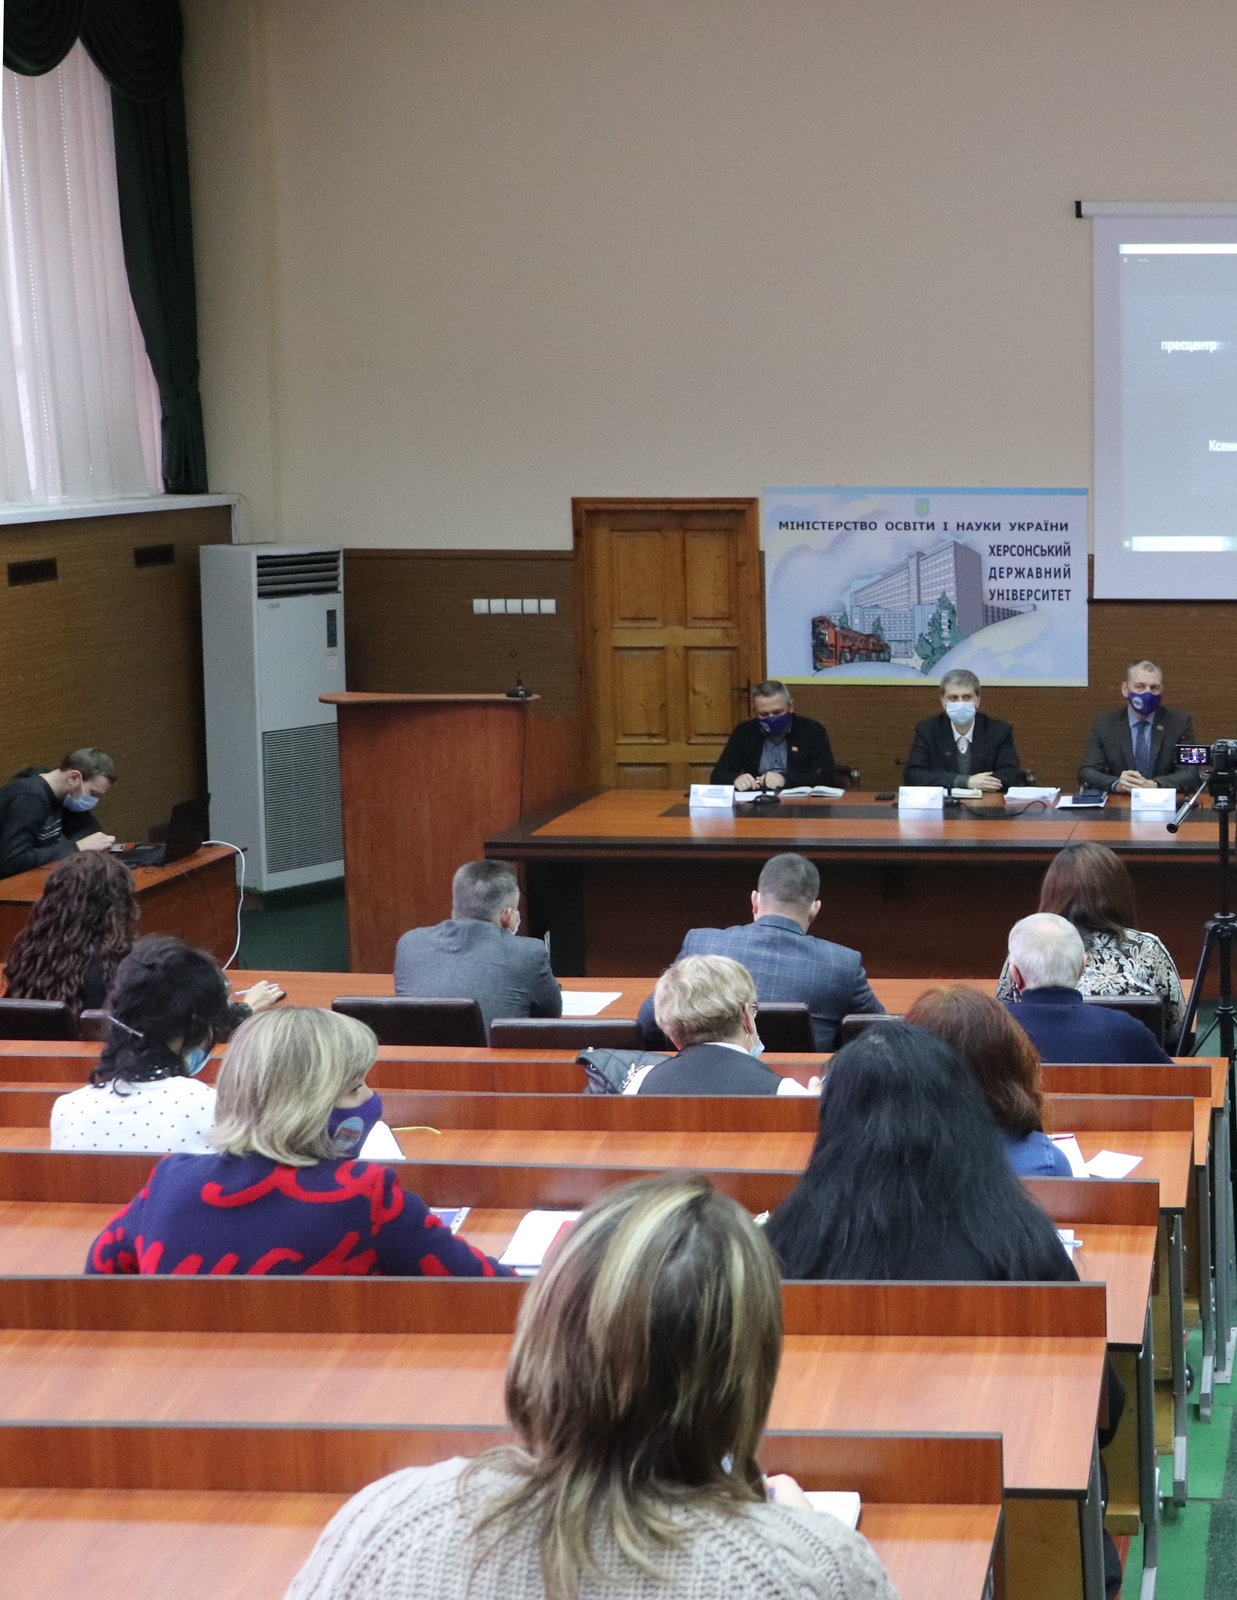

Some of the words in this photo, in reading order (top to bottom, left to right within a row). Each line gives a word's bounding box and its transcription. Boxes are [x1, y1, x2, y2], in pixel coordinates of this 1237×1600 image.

[778, 520, 878, 532] МІНІСТЕРСТВО
[884, 520, 936, 532] ОСВІТИ
[942, 521, 949, 532] І
[956, 521, 1002, 532] НАУКИ
[1008, 519, 1069, 533] УКРАЇНИ
[988, 541, 1071, 557] ХЕРСОНСЬКИЙ
[988, 564, 1071, 581] ДЕРЖАВНИЙ
[988, 588, 1072, 602] УНІВЕРСИТЕТ
